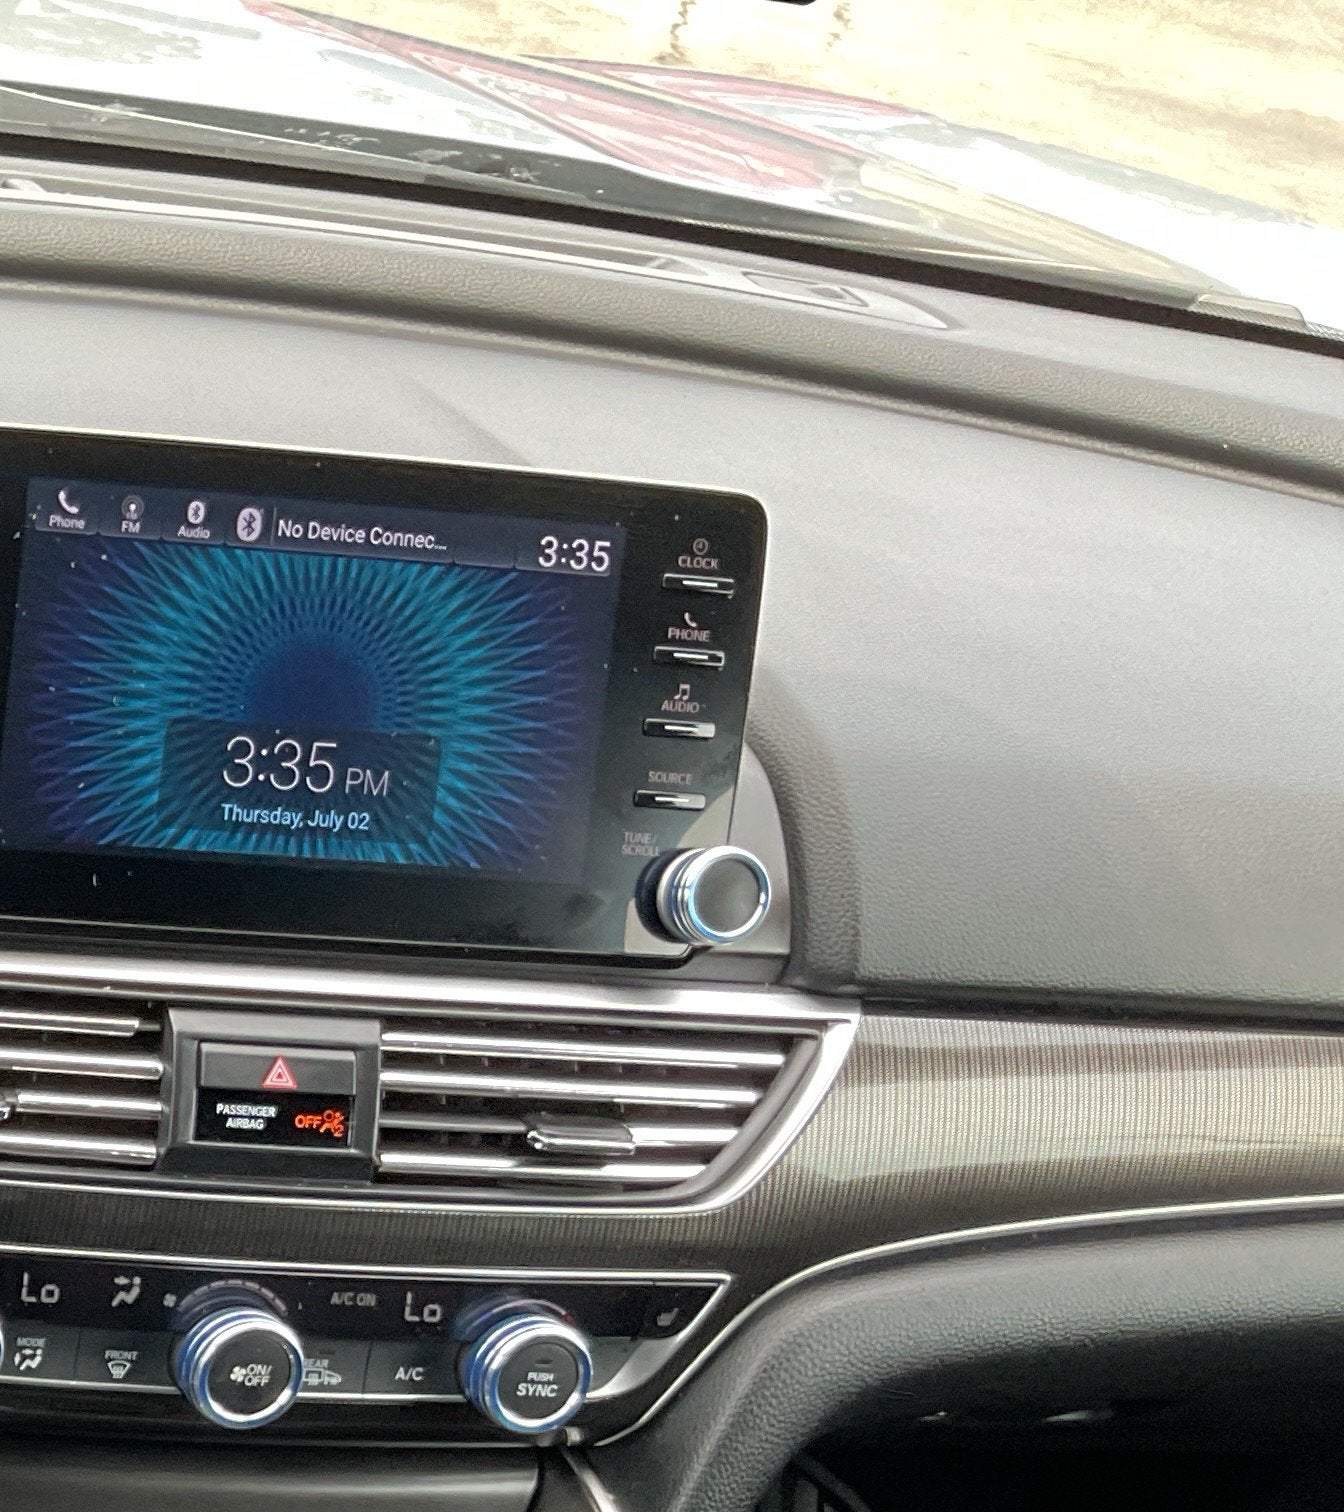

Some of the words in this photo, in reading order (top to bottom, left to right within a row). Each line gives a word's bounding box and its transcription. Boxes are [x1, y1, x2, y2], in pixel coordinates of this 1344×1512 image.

[48, 514, 85, 530] Phone
[121, 520, 141, 534] FM
[177, 525, 211, 539] Audio
[278, 519, 304, 539] No
[308, 521, 366, 543] Device
[538, 536, 611, 572] 3:35
[678, 555, 719, 570] CLOCK
[667, 627, 710, 642] PHONE
[661, 699, 700, 714] AUDIO
[223, 736, 337, 793] 3:35
[345, 767, 391, 797] PM
[648, 770, 693, 785] SOURCE
[221, 803, 304, 829] Thursday,
[308, 808, 344, 832] July
[346, 810, 371, 831] 02
[623, 830, 657, 846] TUNE/
[216, 1103, 277, 1118] PASSENGER
[226, 1117, 266, 1131] AIRBAG
[295, 1114, 322, 1129] OFF
[330, 1291, 355, 1306] A/C
[357, 1292, 376, 1306] ON
[16, 1336, 45, 1348] MODE
[105, 1349, 139, 1362] FRONT
[245, 1363, 272, 1376] ON/
[395, 1365, 425, 1382] A/C
[526, 1371, 555, 1382] PUSH
[244, 1374, 271, 1387] OFF
[516, 1382, 559, 1399] SYNC
